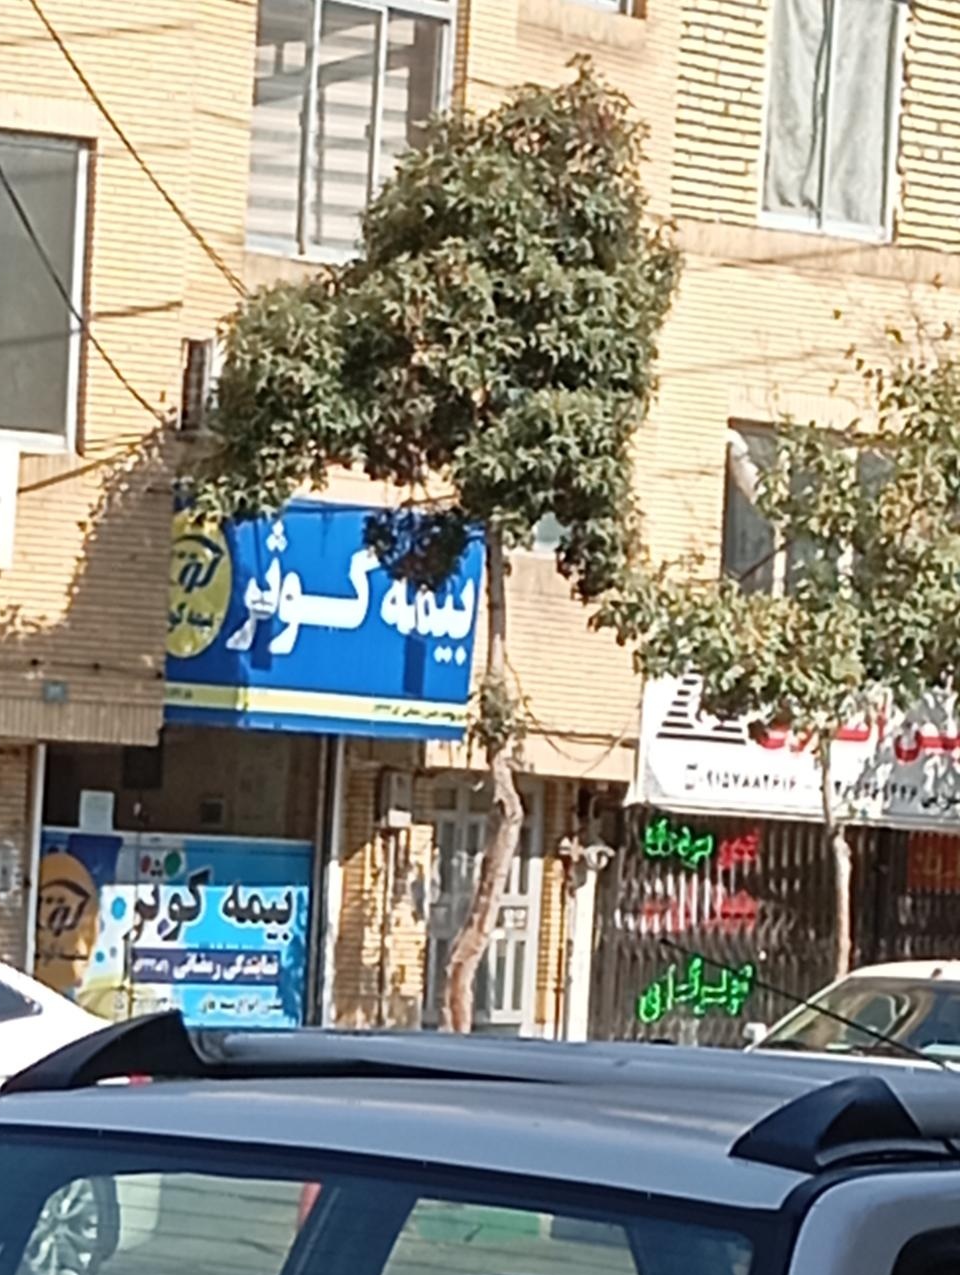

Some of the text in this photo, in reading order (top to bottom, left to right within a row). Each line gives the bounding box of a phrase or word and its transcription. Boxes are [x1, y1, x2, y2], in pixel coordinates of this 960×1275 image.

[226, 520, 383, 655] کوثر
[380, 577, 475, 666] بیمه
[222, 881, 293, 941] بیمه
